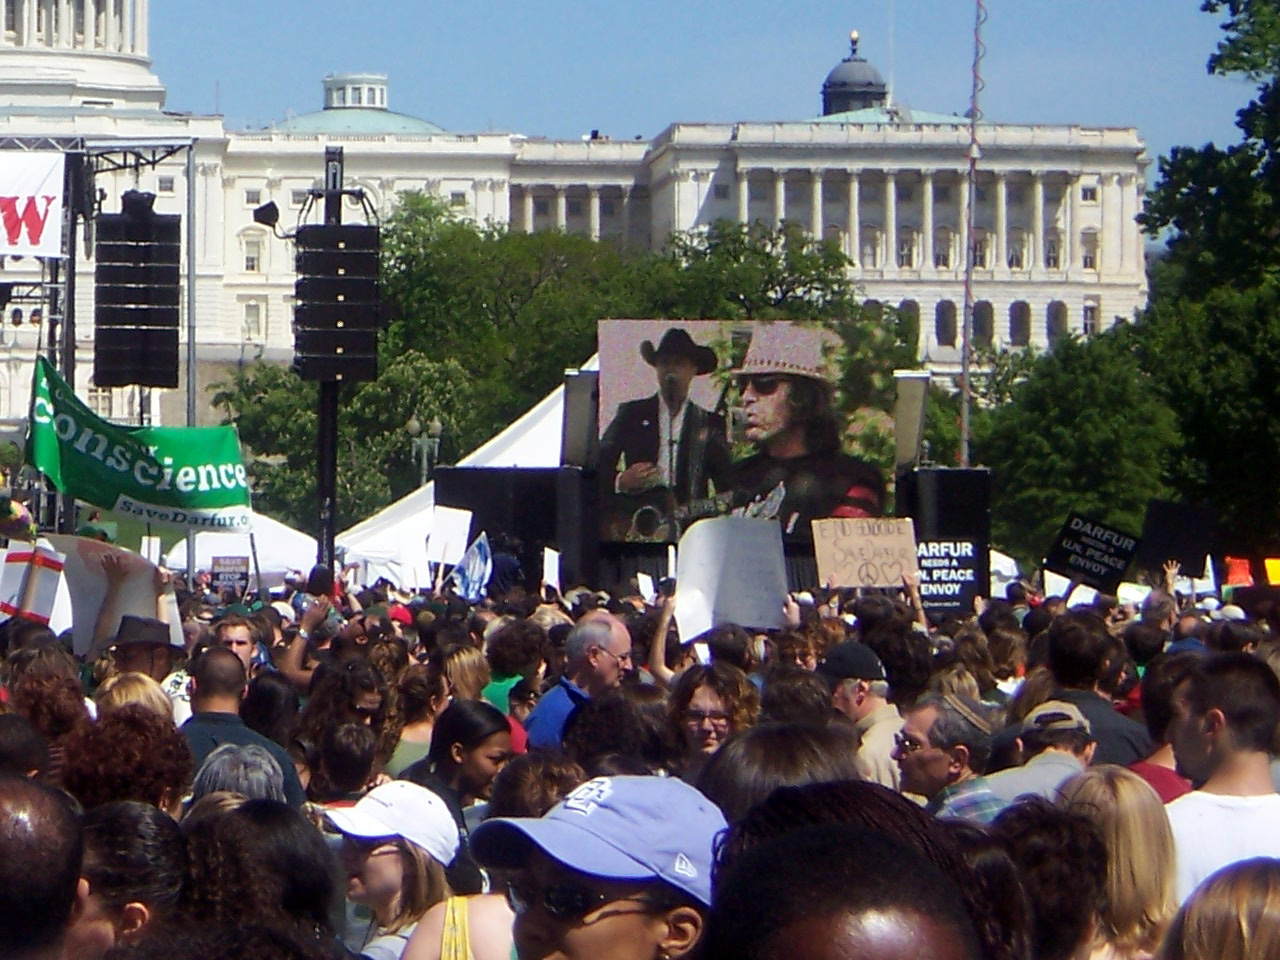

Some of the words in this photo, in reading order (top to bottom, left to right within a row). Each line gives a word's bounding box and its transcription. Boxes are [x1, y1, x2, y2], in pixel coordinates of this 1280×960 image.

[121, 498, 250, 527] SaveDarfur.o
[1070, 517, 1136, 551] DARFUR
[916, 541, 974, 558] ARFUR
[932, 569, 975, 582] PEACE
[920, 582, 962, 596] ENVOY
